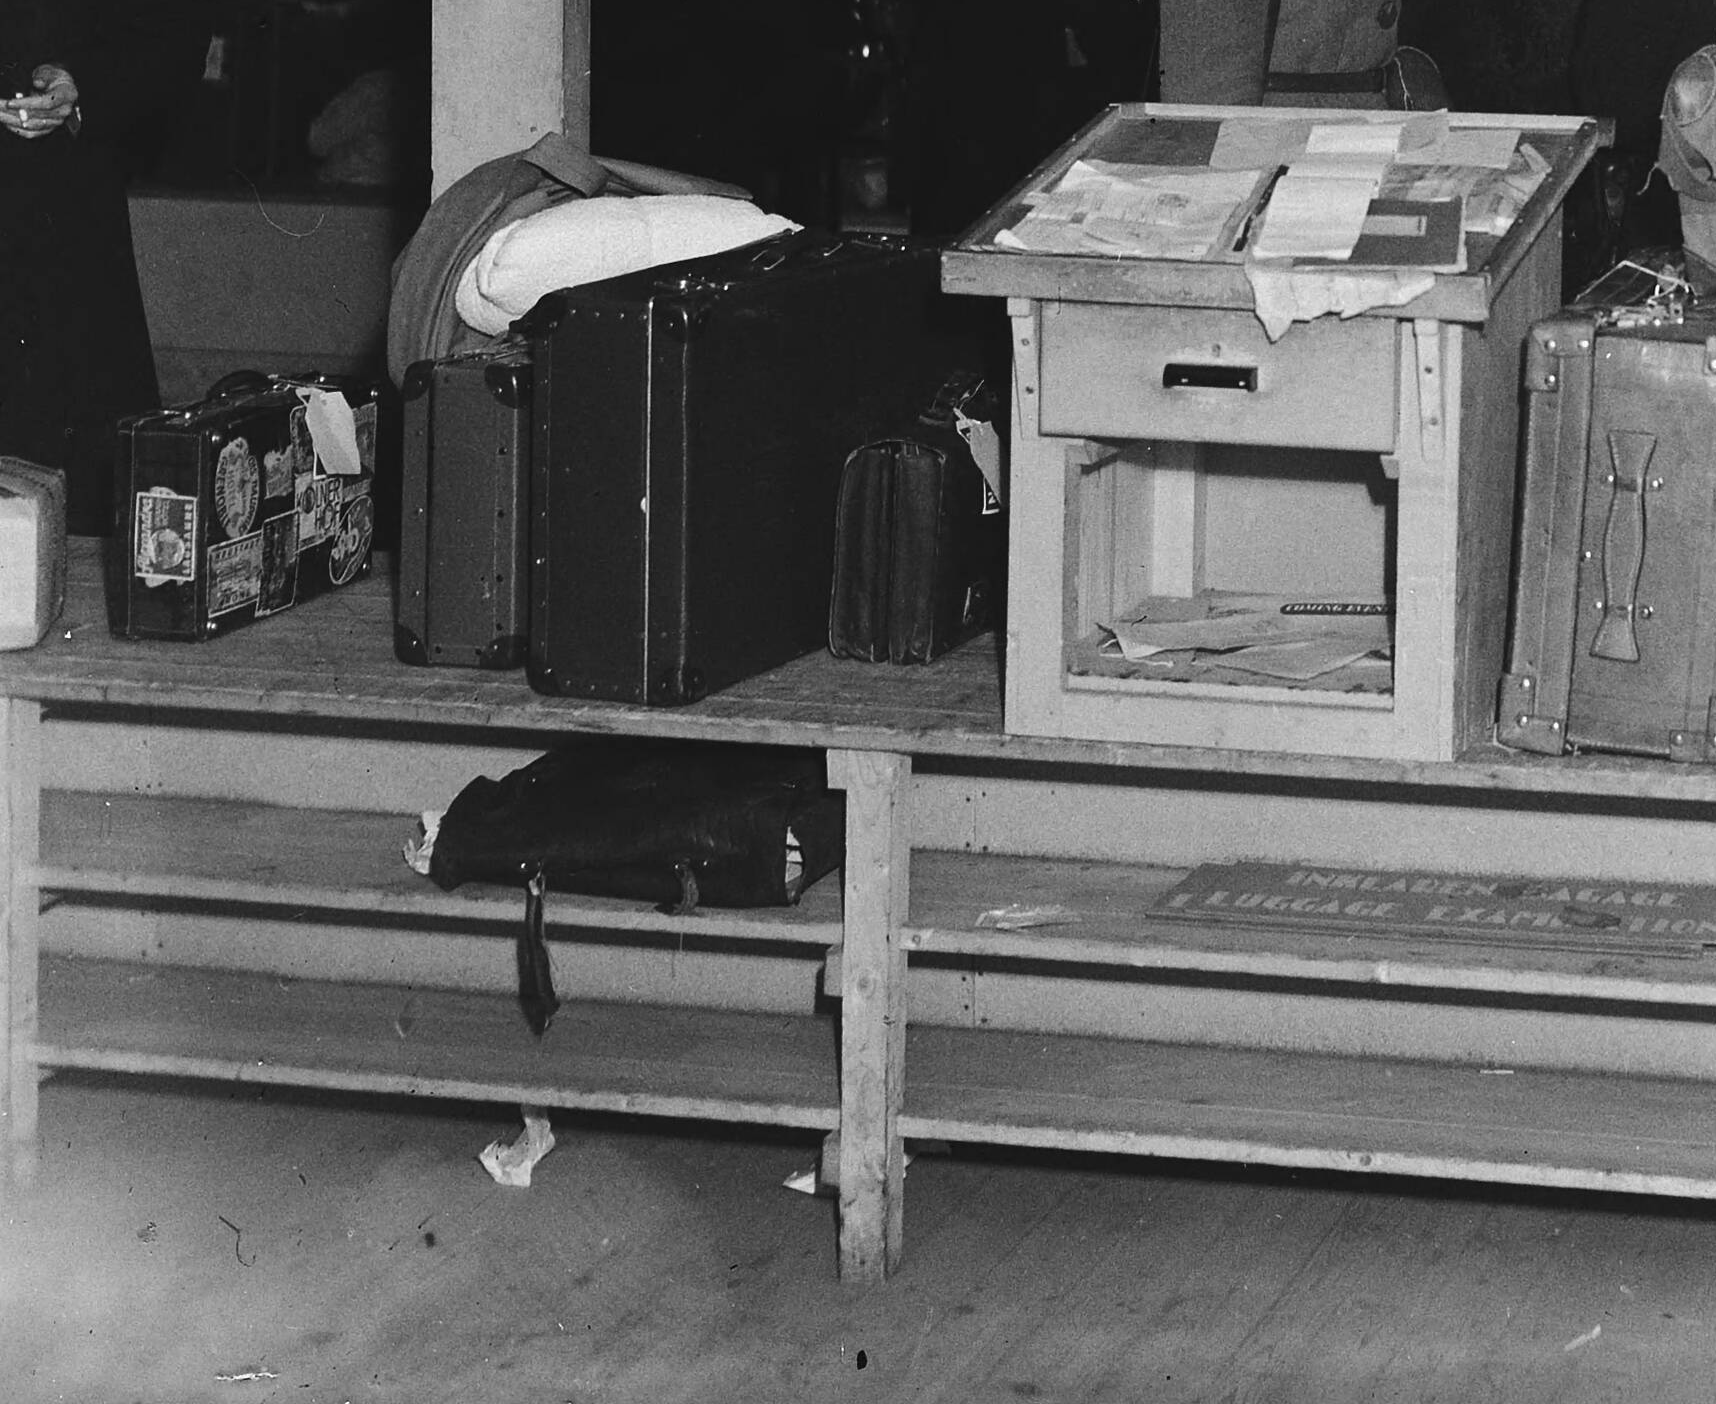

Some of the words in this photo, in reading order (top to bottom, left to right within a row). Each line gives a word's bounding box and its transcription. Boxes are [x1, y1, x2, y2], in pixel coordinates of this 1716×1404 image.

[1284, 604, 1342, 612] COMING
[1346, 604, 1386, 613] EVEN
[1286, 870, 1499, 896] INKLAREN
[1520, 883, 1680, 908] AGAGE
[1205, 891, 1403, 918] LUGGAGE
